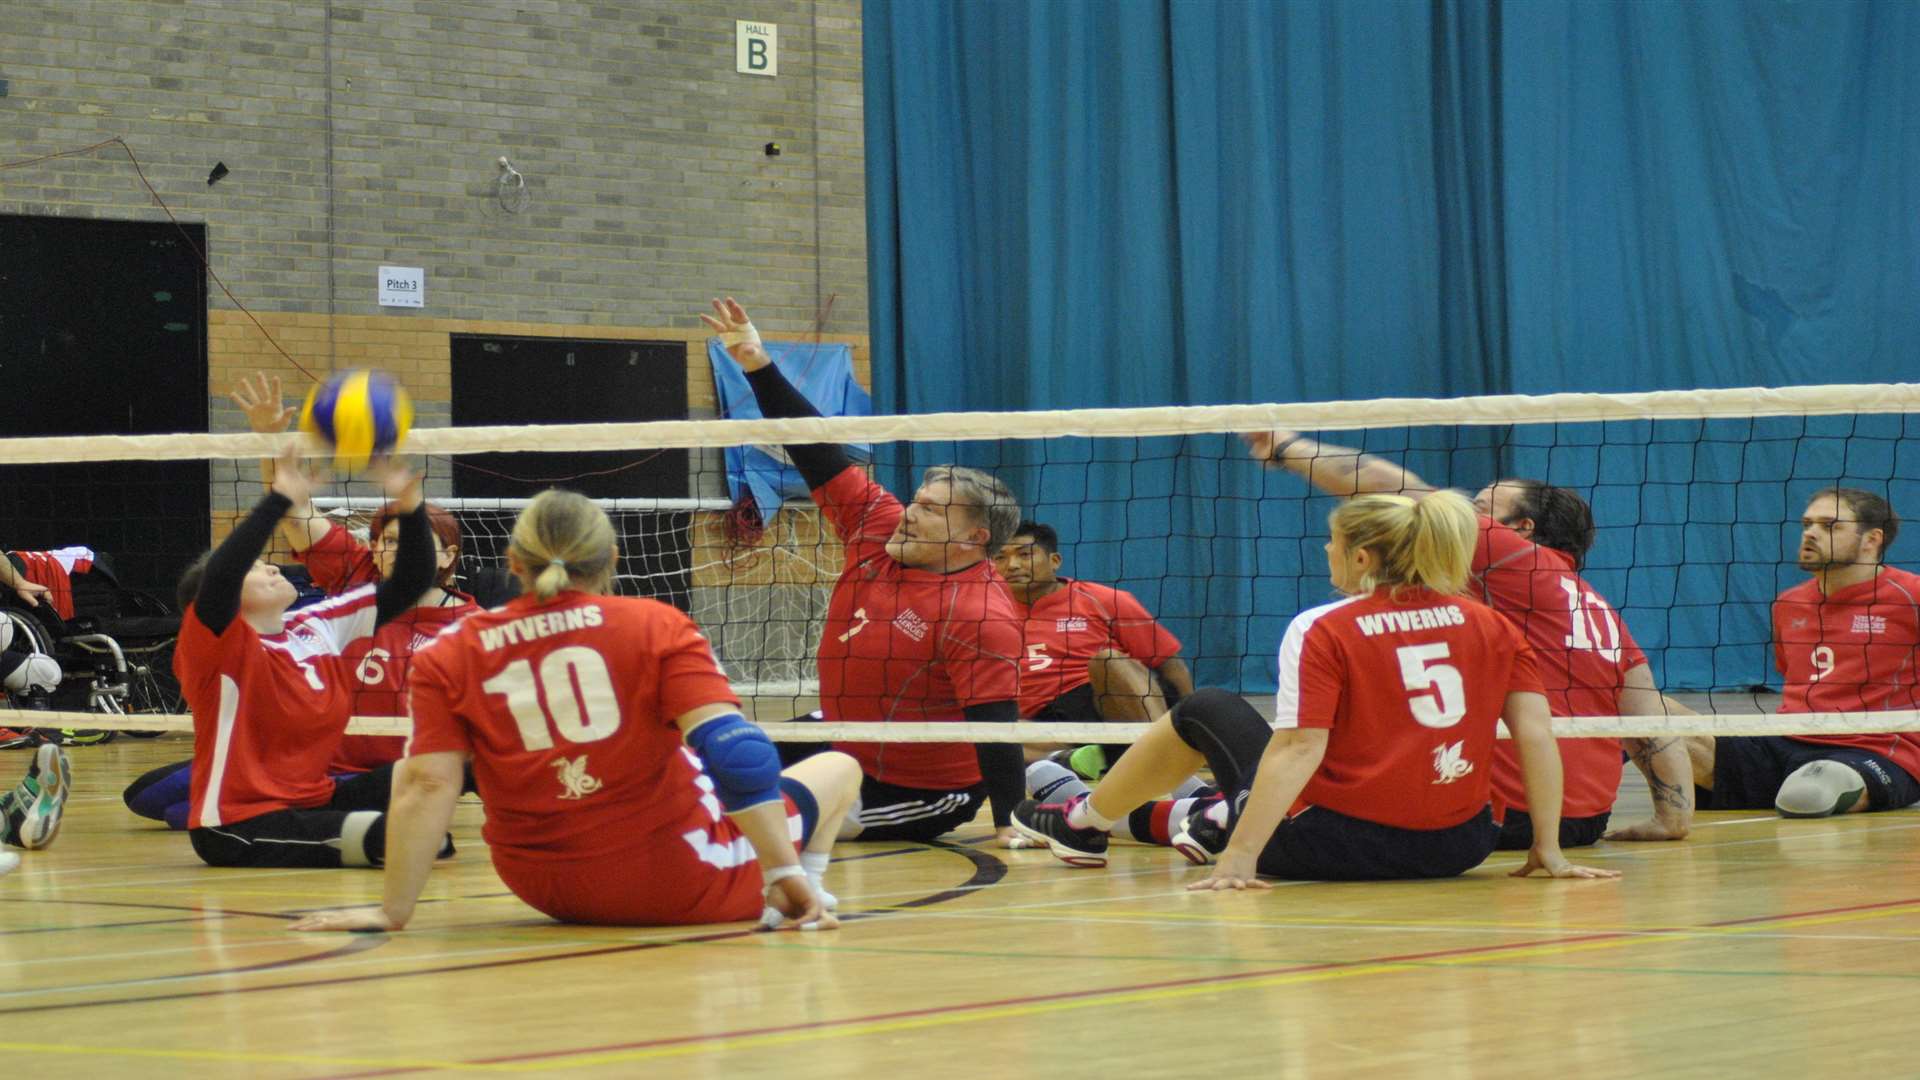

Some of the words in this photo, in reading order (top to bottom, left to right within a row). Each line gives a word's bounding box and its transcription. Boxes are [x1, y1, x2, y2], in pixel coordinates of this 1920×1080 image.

[745, 24, 769, 36] HALL
[748, 38, 768, 70] B
[386, 279, 410, 289] Pitch
[411, 280, 417, 290] 3
[478, 604, 604, 652] WYVERNS
[1356, 604, 1466, 637] WYVERNS
[1560, 575, 1622, 663] 10
[355, 647, 391, 685] 6
[1026, 643, 1053, 672] 5
[1809, 645, 1835, 683] 9
[482, 645, 621, 752] 10
[1396, 641, 1467, 729] 5
